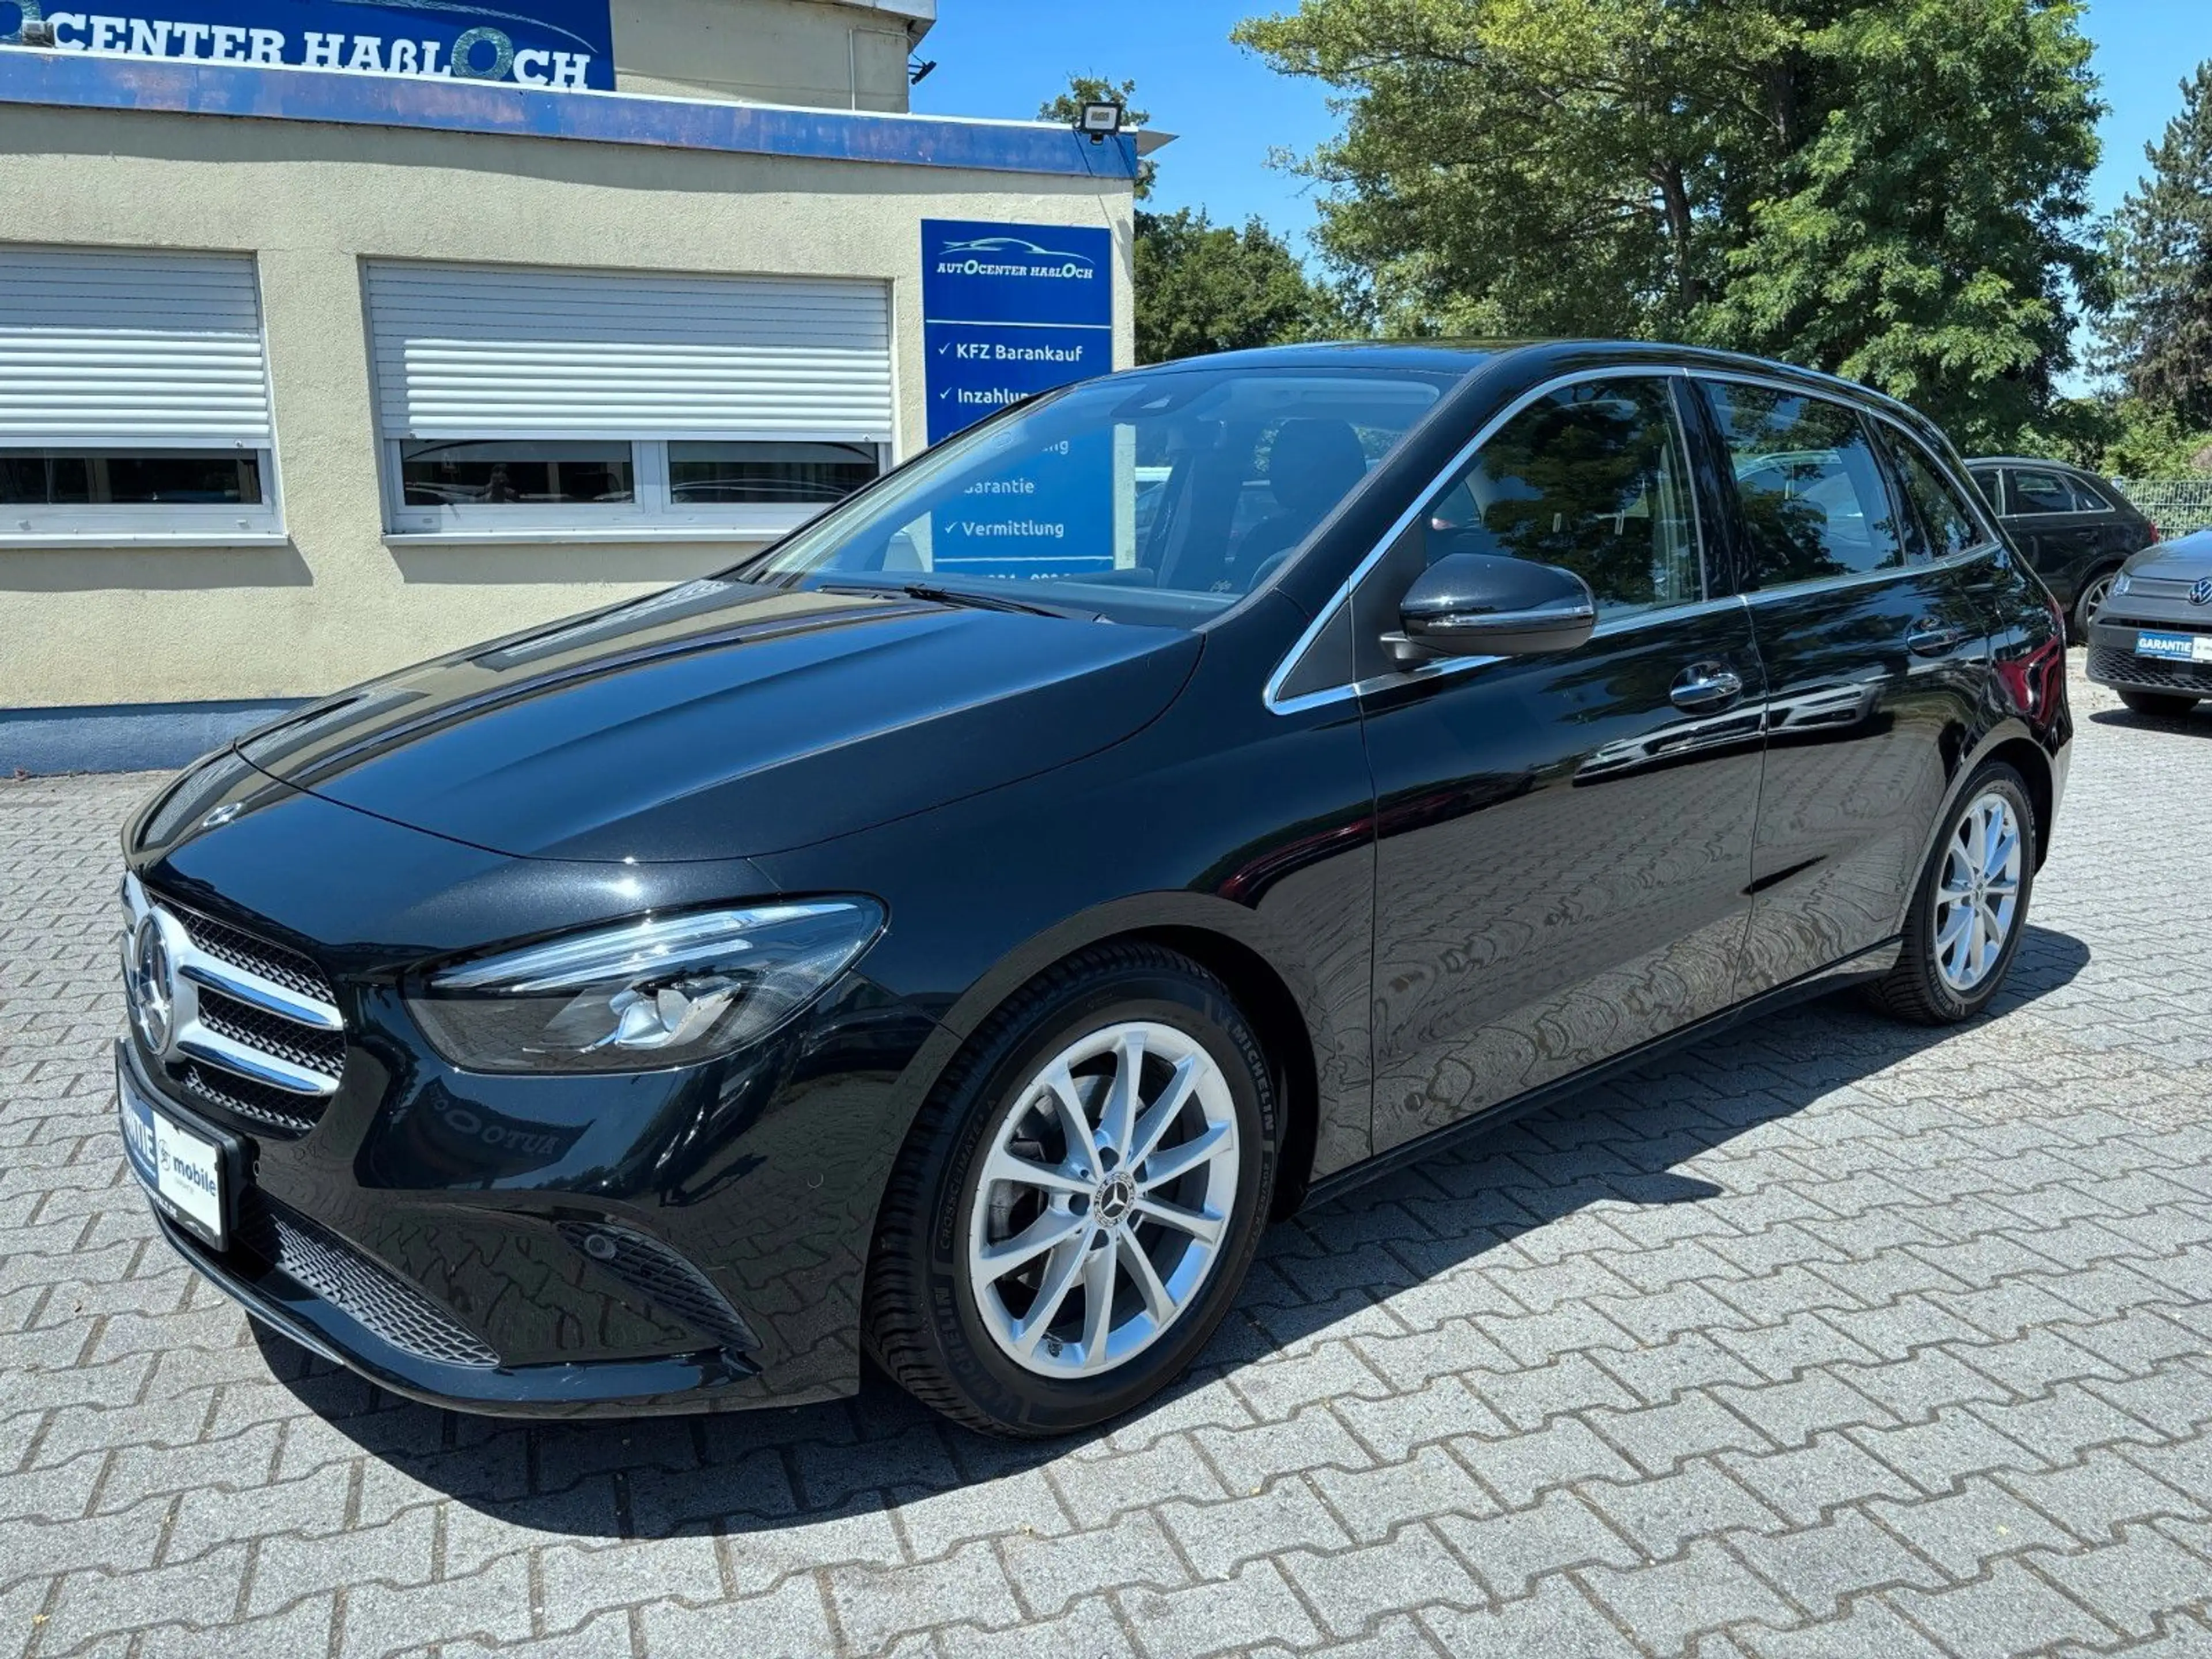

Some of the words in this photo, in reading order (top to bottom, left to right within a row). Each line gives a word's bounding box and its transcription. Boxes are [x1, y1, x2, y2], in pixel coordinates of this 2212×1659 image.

[937, 260, 1027, 276] AUTOCENTER
[957, 344, 991, 359] KFZ
[996, 344, 1082, 362] Barankauf
[962, 521, 1065, 538] Vermittlung
[2138, 637, 2192, 653] GARANTIE
[173, 1156, 217, 1196] mobile
